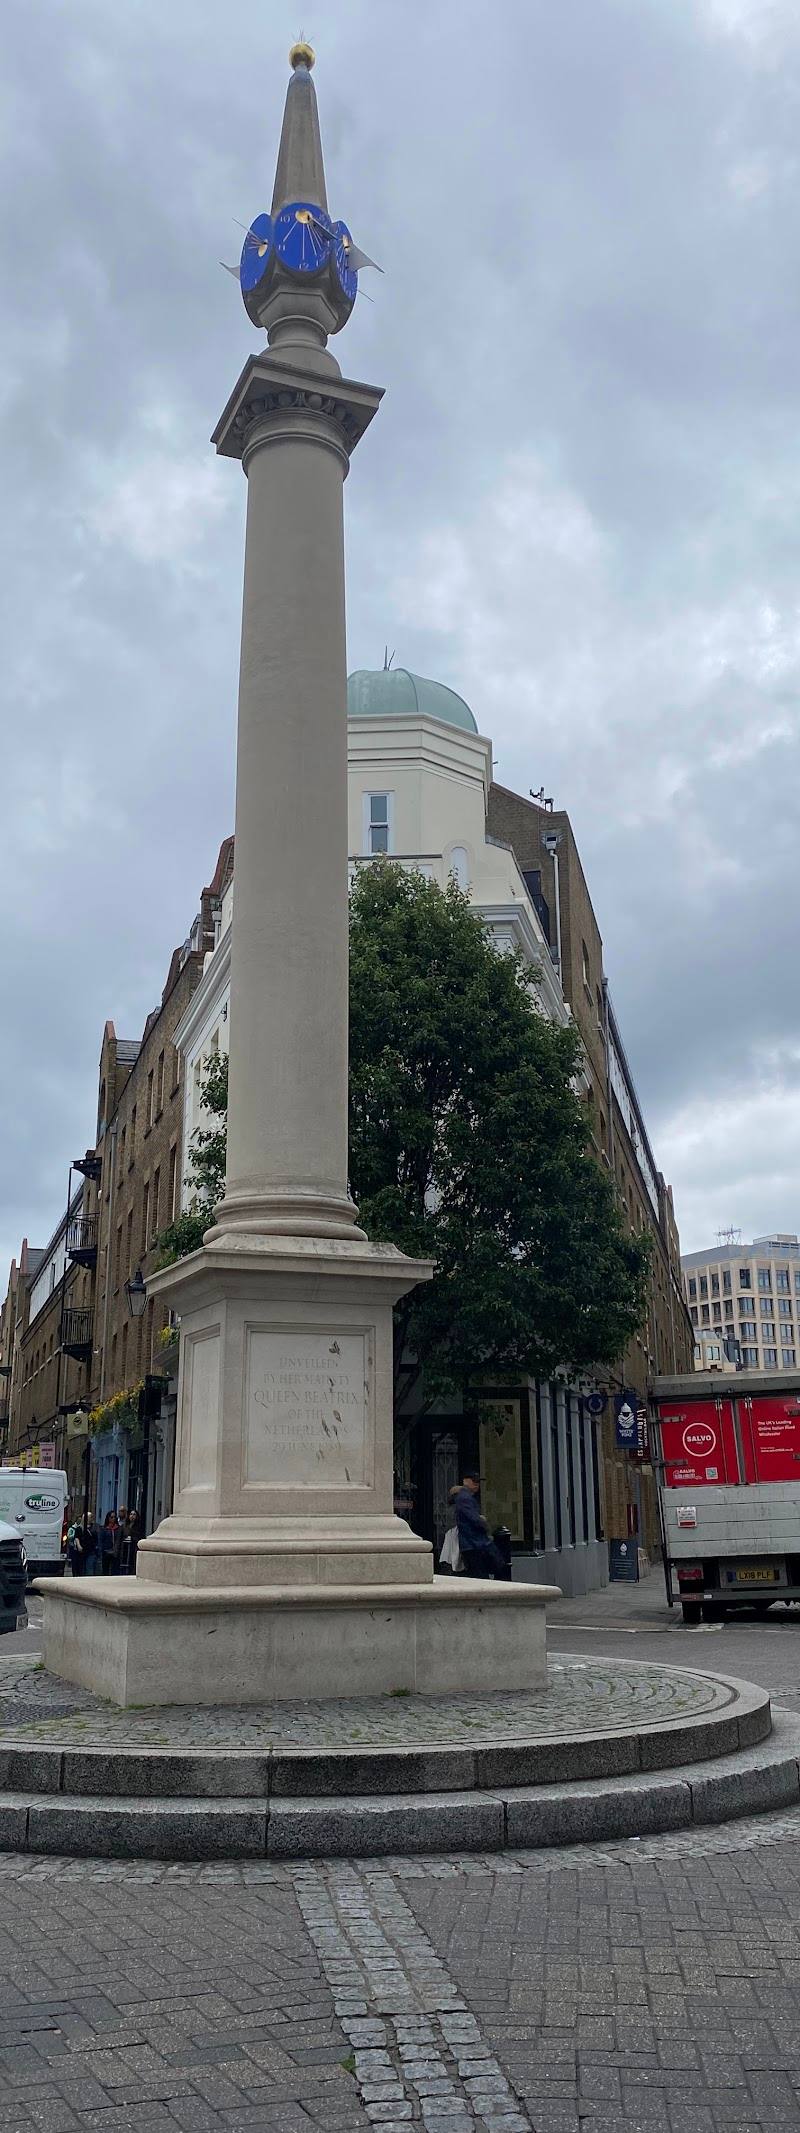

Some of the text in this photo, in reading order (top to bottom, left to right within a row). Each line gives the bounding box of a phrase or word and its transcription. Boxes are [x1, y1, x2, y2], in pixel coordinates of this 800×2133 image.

[279, 1357, 338, 1369] UNVEILED
[263, 1373, 275, 1384] BY
[279, 1373, 301, 1385] HER
[254, 1390, 359, 1407] QUEEN BEATRIX
[287, 1408, 326, 1420] OF THE
[686, 1434, 712, 1443] SALVO
[28, 1498, 56, 1507] truline
[757, 1570, 772, 1579] PLF
